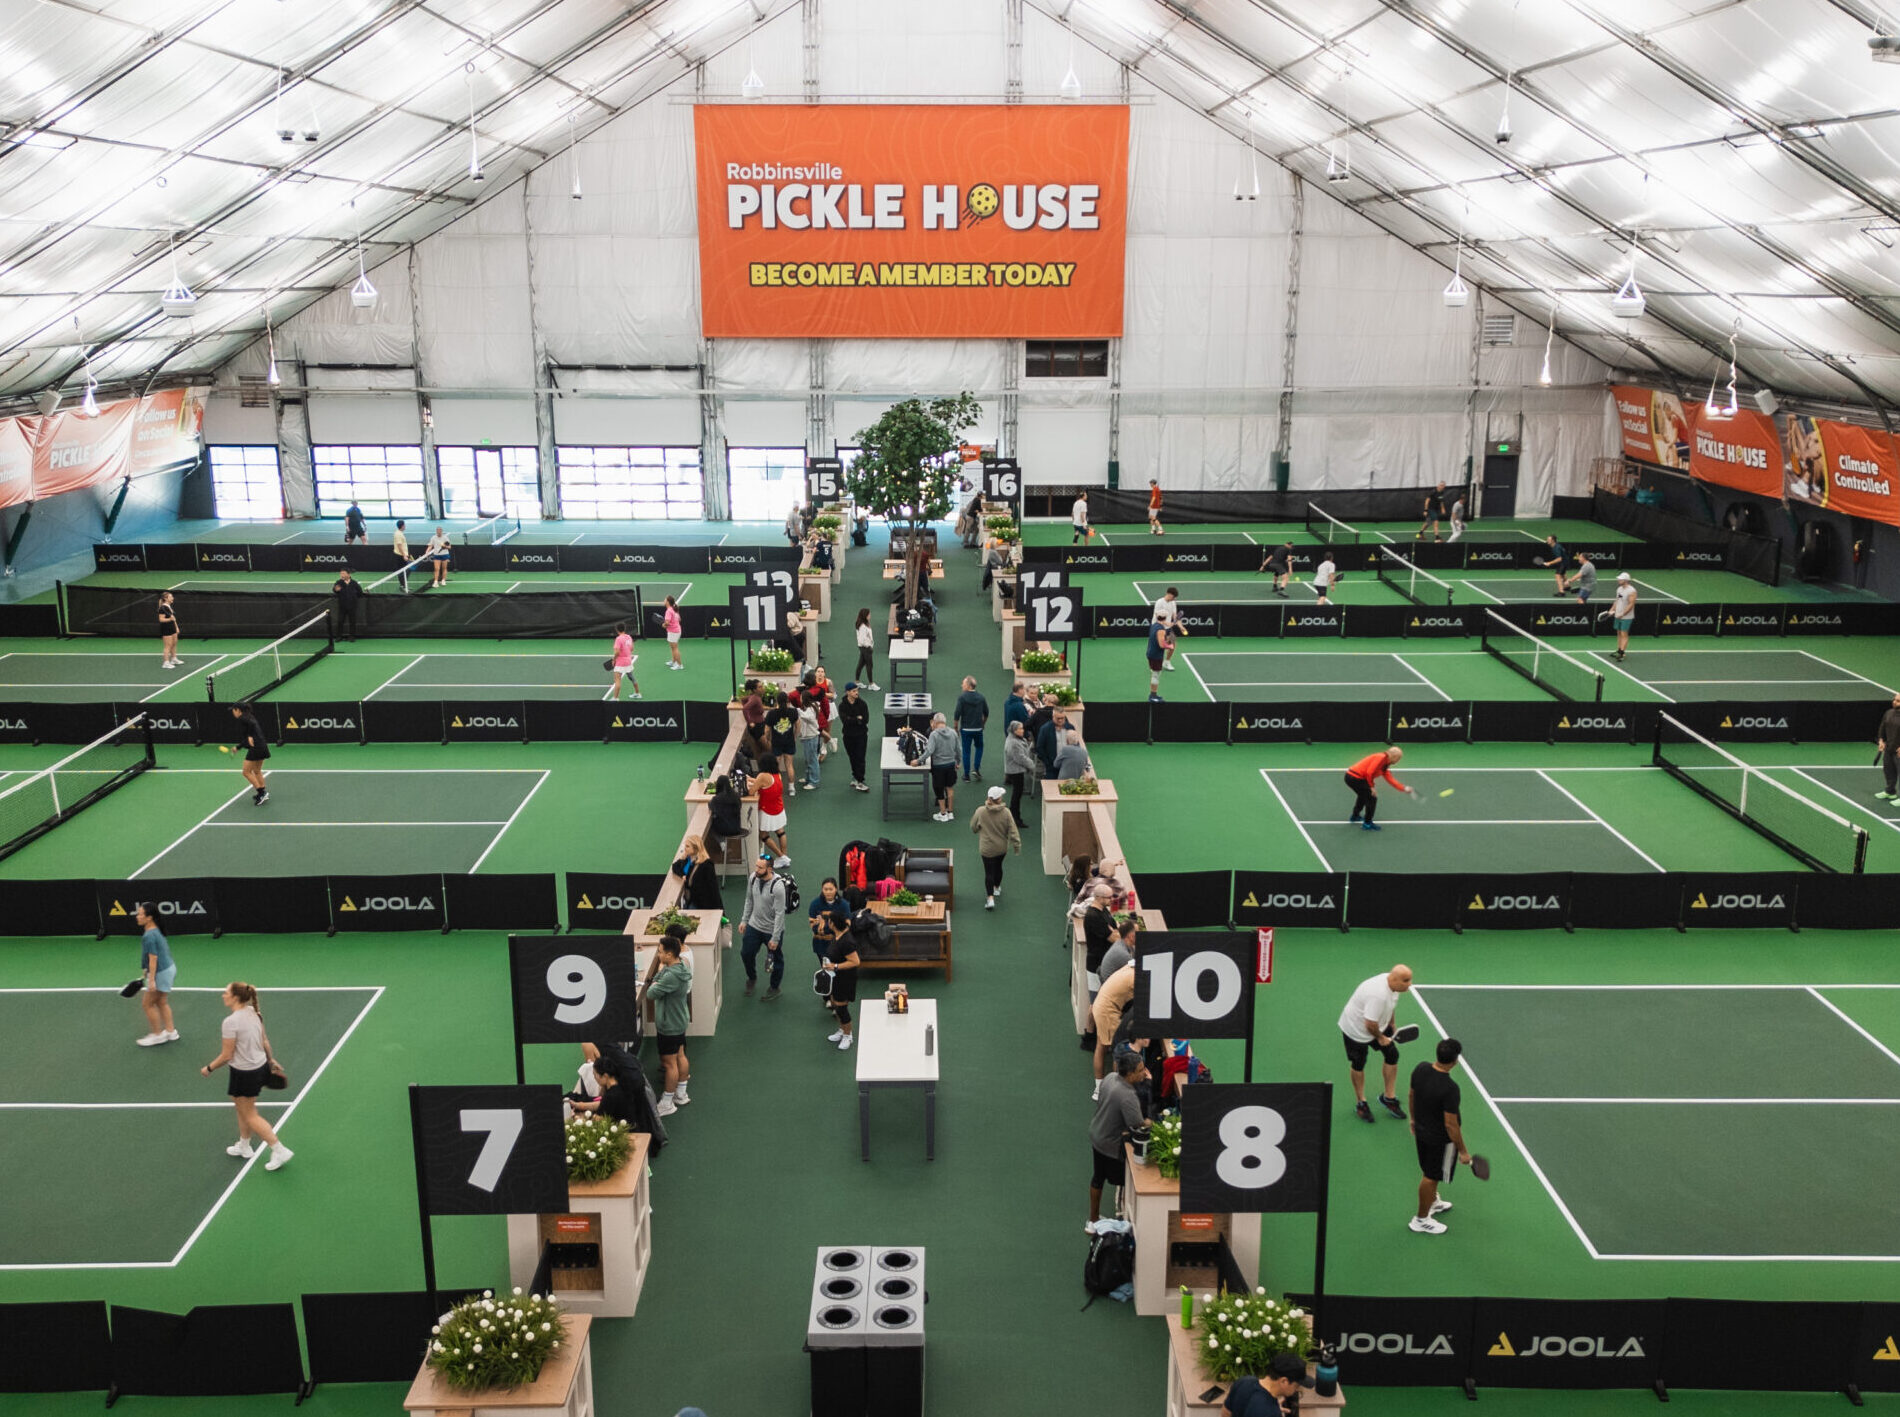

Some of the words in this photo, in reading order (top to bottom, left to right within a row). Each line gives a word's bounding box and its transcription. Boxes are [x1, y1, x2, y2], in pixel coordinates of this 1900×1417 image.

[727, 163, 843, 180] Robbinsville
[727, 184, 905, 229] PICKLE
[923, 183, 1099, 230] HOUSE
[750, 263, 858, 287] BECOME
[860, 264, 879, 287] A
[880, 264, 987, 287] MEMBER
[989, 264, 1075, 287] TODAY
[1696, 436, 1726, 461] PICKLE
[1727, 443, 1768, 469] HOUSE
[1838, 454, 1880, 476] Climate
[808, 473, 837, 496] 15
[989, 473, 1017, 496] 16
[1834, 472, 1891, 496] Controlled
[107, 554, 141, 562] JOOLA
[210, 554, 246, 562] JOOLA
[313, 555, 348, 563] JOOLA
[519, 555, 554, 563] JOOLA
[622, 555, 656, 563] JOOLA
[722, 555, 757, 563] JOOLA
[1074, 555, 1109, 564] JOOLA
[1174, 554, 1209, 562] JOOLA
[1478, 552, 1513, 561] JOOLA
[1685, 552, 1722, 562] JOOLA
[743, 595, 777, 631] 11
[1032, 596, 1073, 632] 12
[1110, 617, 1151, 627] JOOLA
[1180, 617, 1215, 626] OOLA
[1297, 617, 1338, 626] JOOLA
[1421, 617, 1464, 627] JOOLA
[1546, 615, 1589, 625] JOOLA
[1673, 615, 1714, 625] JOOLA
[1735, 615, 1778, 625] JOOLA
[1799, 615, 1842, 625] JOOLA
[301, 717, 355, 729] JOOLA
[466, 716, 518, 728] JOOLA
[626, 716, 677, 728] JOOLA
[1250, 717, 1302, 729] JOOLA
[1410, 717, 1462, 729] JOOLA
[1573, 717, 1626, 729] JOOLA
[1735, 717, 1788, 728] JOOLA
[360, 897, 434, 911] JOOLA
[1262, 894, 1335, 909] JOOLA
[1488, 896, 1560, 910] JOOLA
[1711, 895, 1785, 909] JOOLA
[130, 901, 207, 916] JOLA
[546, 954, 607, 1024] 9
[1142, 950, 1242, 1021] 10
[459, 1109, 523, 1193] 7
[1215, 1105, 1287, 1189] 8
[1336, 1333, 1454, 1355] JOOLA
[1520, 1336, 1645, 1357] JOOLA
